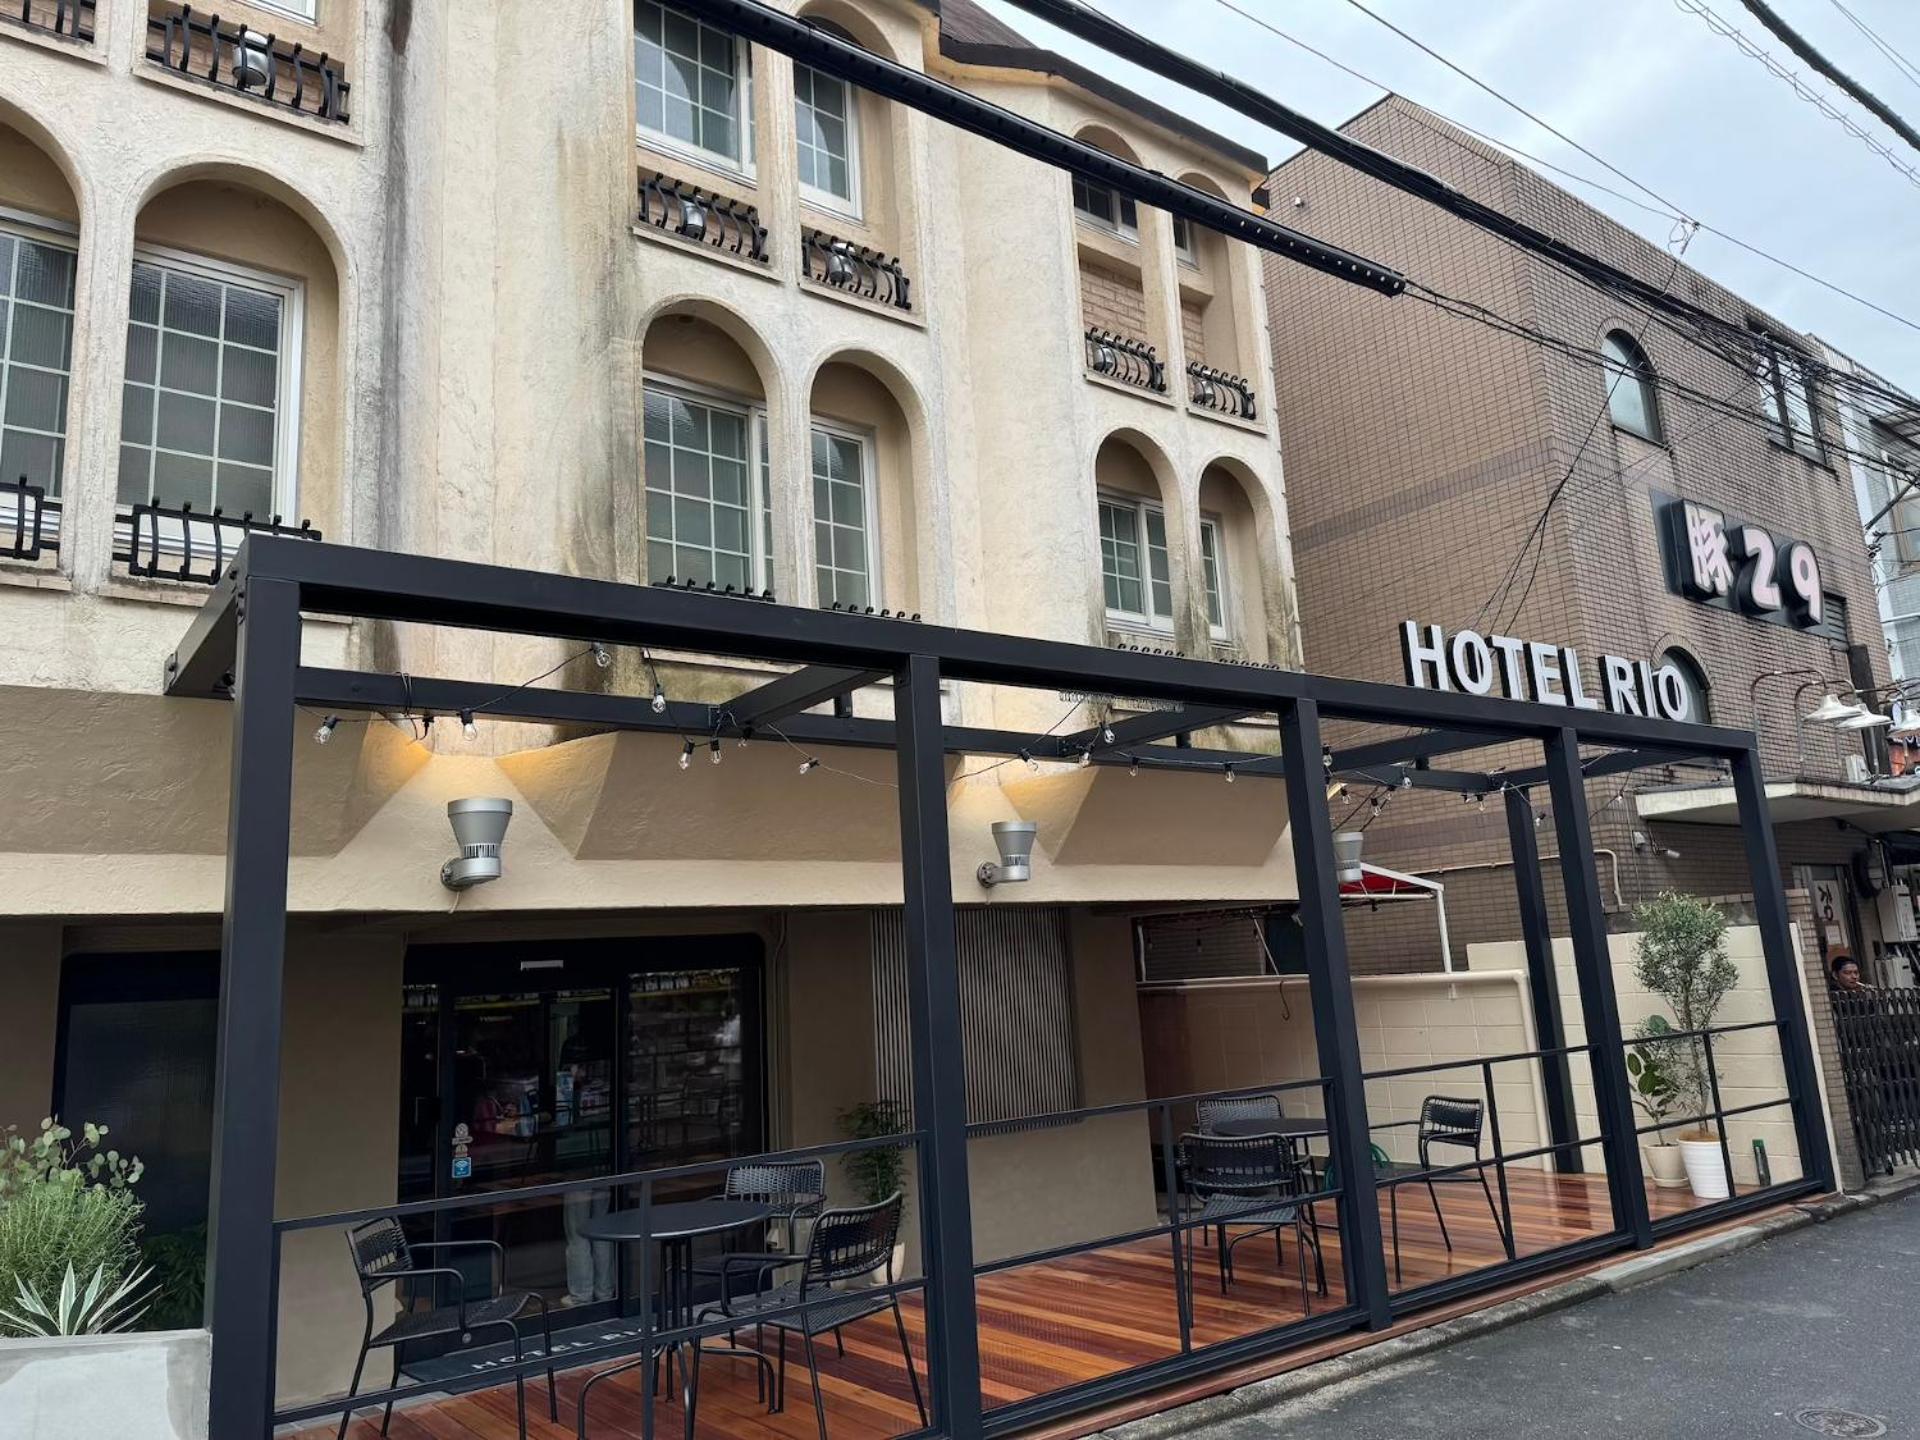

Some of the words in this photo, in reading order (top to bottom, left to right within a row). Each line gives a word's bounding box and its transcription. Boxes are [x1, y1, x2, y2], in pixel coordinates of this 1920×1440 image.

[1682, 500, 1823, 626] 豚29
[1402, 620, 1598, 711] HOTEL
[1602, 655, 1689, 722] RIO
